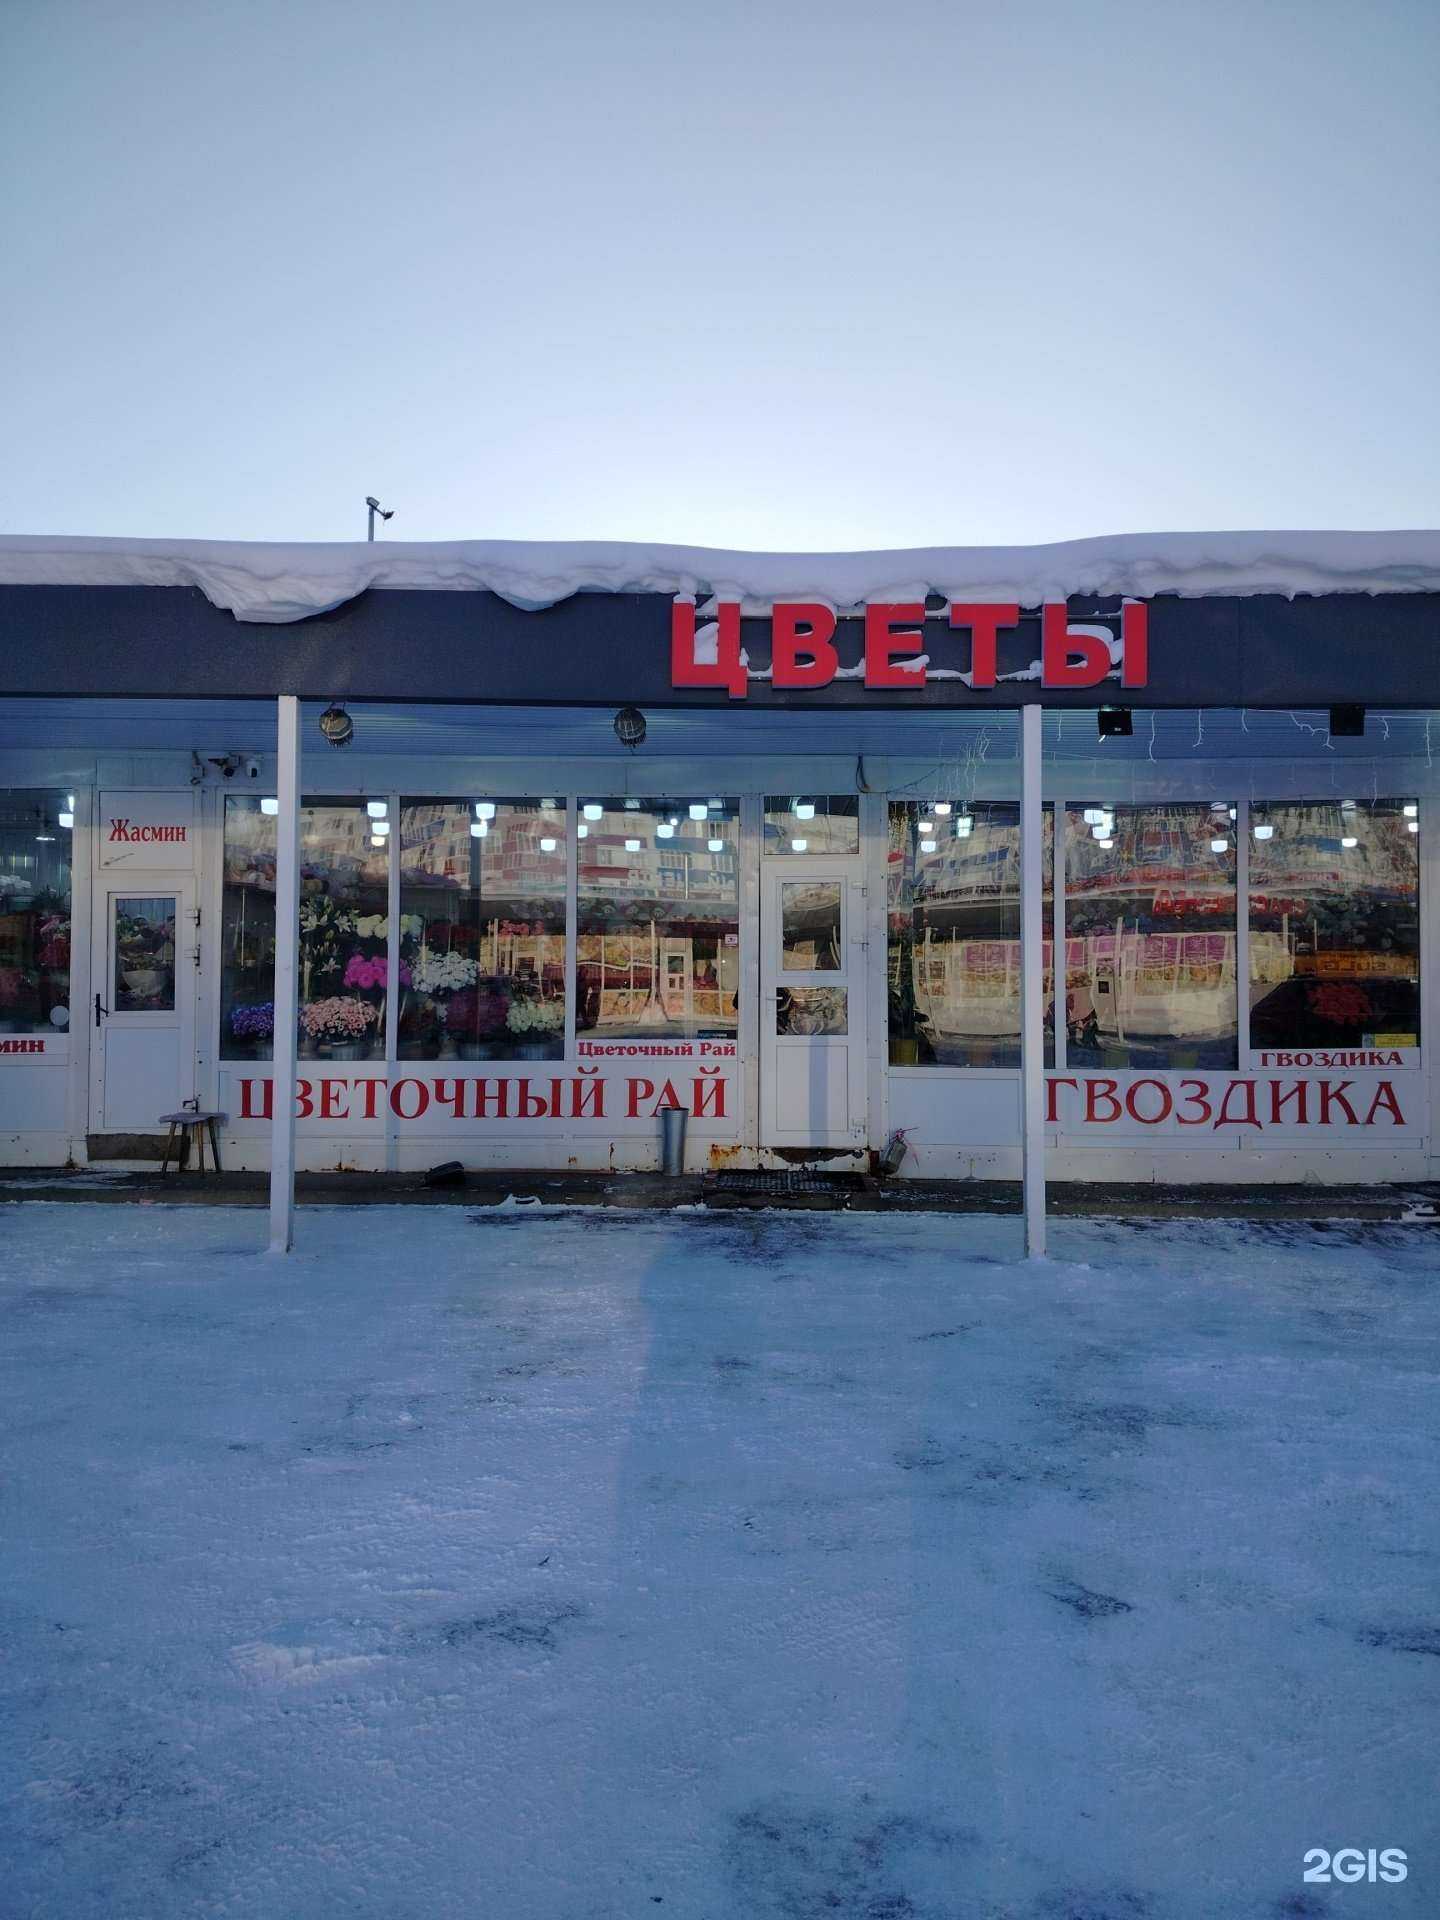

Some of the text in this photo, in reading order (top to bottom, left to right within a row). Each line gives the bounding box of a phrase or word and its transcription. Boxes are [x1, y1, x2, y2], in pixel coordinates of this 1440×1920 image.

[672, 601, 1148, 699] ЦВЕТЫ
[109, 818, 187, 842] Жасмин
[578, 1042, 736, 1058] Цветочный Рай
[1260, 1051, 1405, 1069] ГВОЗДИКА
[624, 1065, 730, 1118] РАЙ
[1044, 1077, 1407, 1130] ГВОЗДИКА
